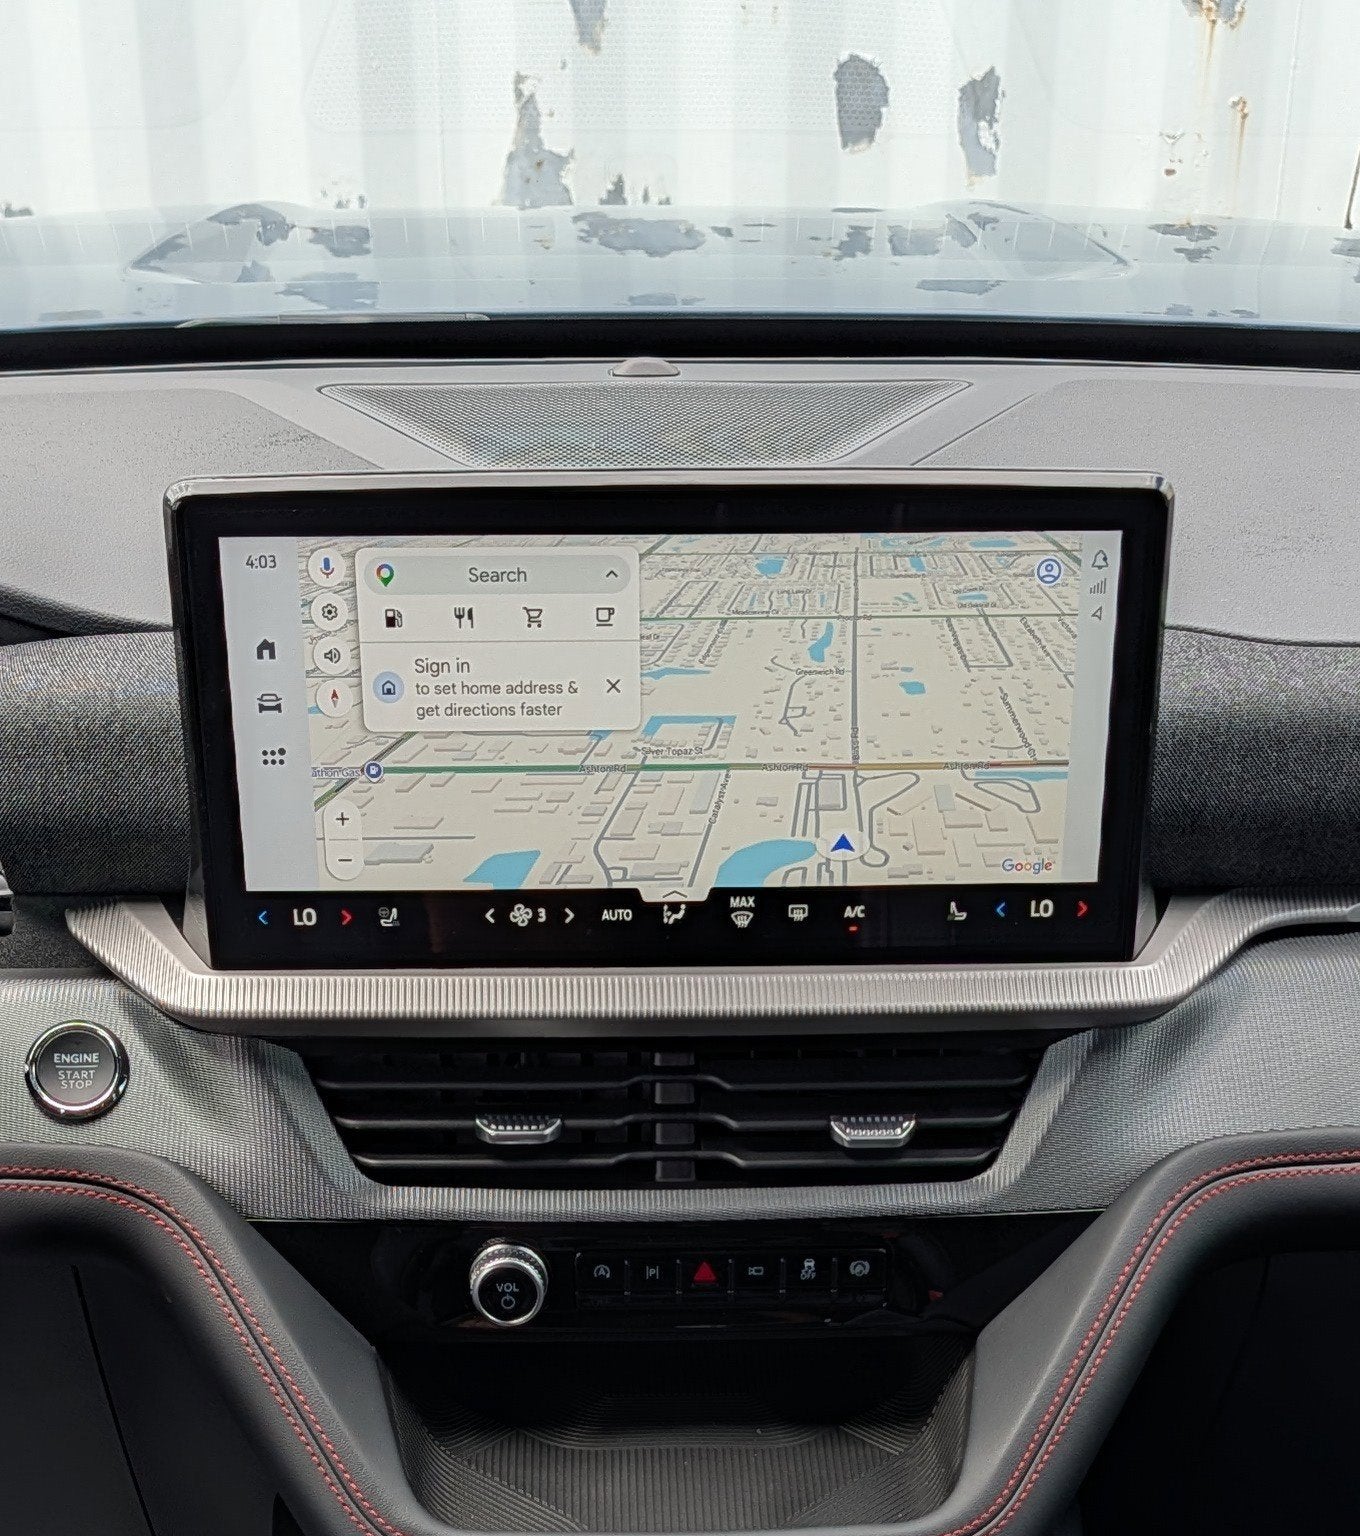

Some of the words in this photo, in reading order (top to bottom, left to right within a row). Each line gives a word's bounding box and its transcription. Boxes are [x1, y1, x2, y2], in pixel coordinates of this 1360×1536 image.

[246, 555, 277, 570] 4:03
[468, 566, 527, 583] Search
[414, 658, 450, 677] Sign
[455, 658, 470, 674] in
[415, 682, 431, 695] to
[434, 682, 457, 696] set
[461, 682, 502, 695] home
[506, 681, 564, 695] address
[568, 681, 579, 694] &
[416, 704, 440, 720] get
[443, 703, 516, 717] directions
[520, 702, 563, 716] faster
[340, 767, 361, 778] Gas
[579, 764, 612, 773] Ashton
[613, 764, 627, 773] Rd
[762, 763, 794, 771] Ashton
[943, 762, 974, 770] Ashton
[1002, 858, 1053, 874] Google
[729, 896, 755, 908] MAX
[1030, 900, 1054, 917] LO
[293, 907, 317, 926] LO
[537, 909, 547, 923] 3
[601, 908, 633, 921] AUTO
[844, 905, 866, 918] A/C
[53, 1052, 100, 1063] ENGINE
[58, 1070, 96, 1080] START
[61, 1080, 93, 1089] STOP
[496, 1282, 519, 1293] VOL
